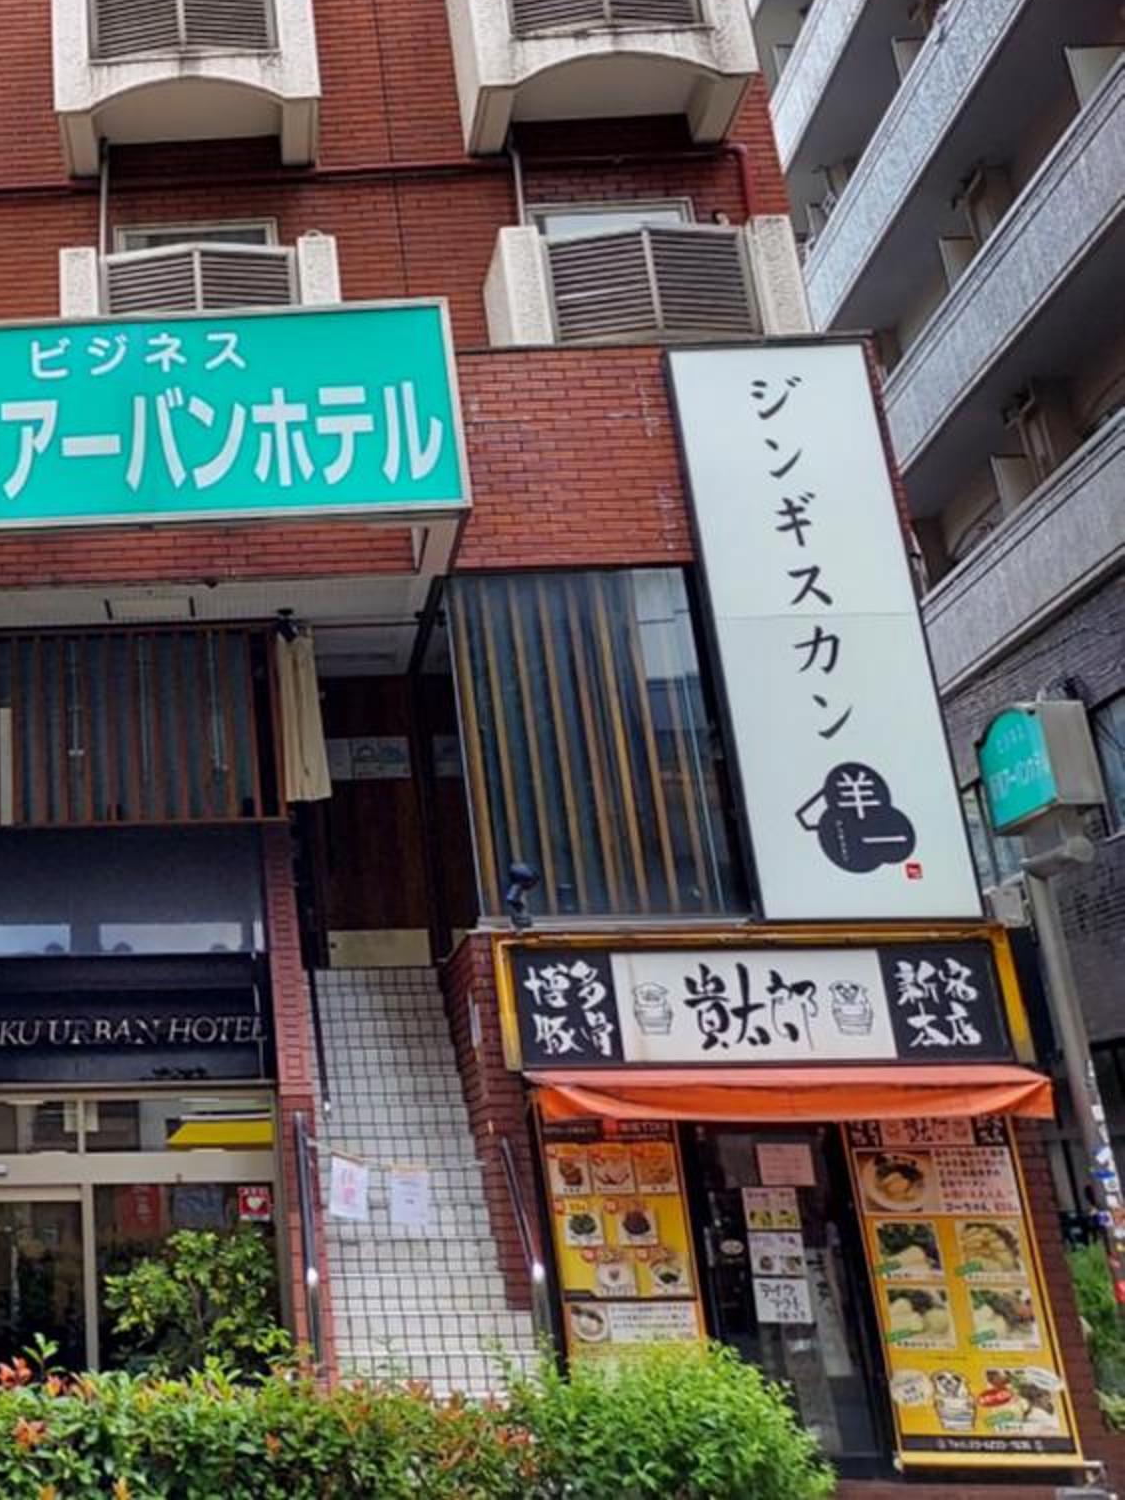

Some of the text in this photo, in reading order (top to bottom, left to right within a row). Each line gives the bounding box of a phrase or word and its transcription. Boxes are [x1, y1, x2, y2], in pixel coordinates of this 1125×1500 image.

[30, 331, 247, 380] ビジネス
[749, 375, 854, 741] ジンギスカン
[48, 1017, 161, 1047] URBAN
[168, 1015, 268, 1044] HOTEL
[683, 962, 818, 1052] 貴太郎
